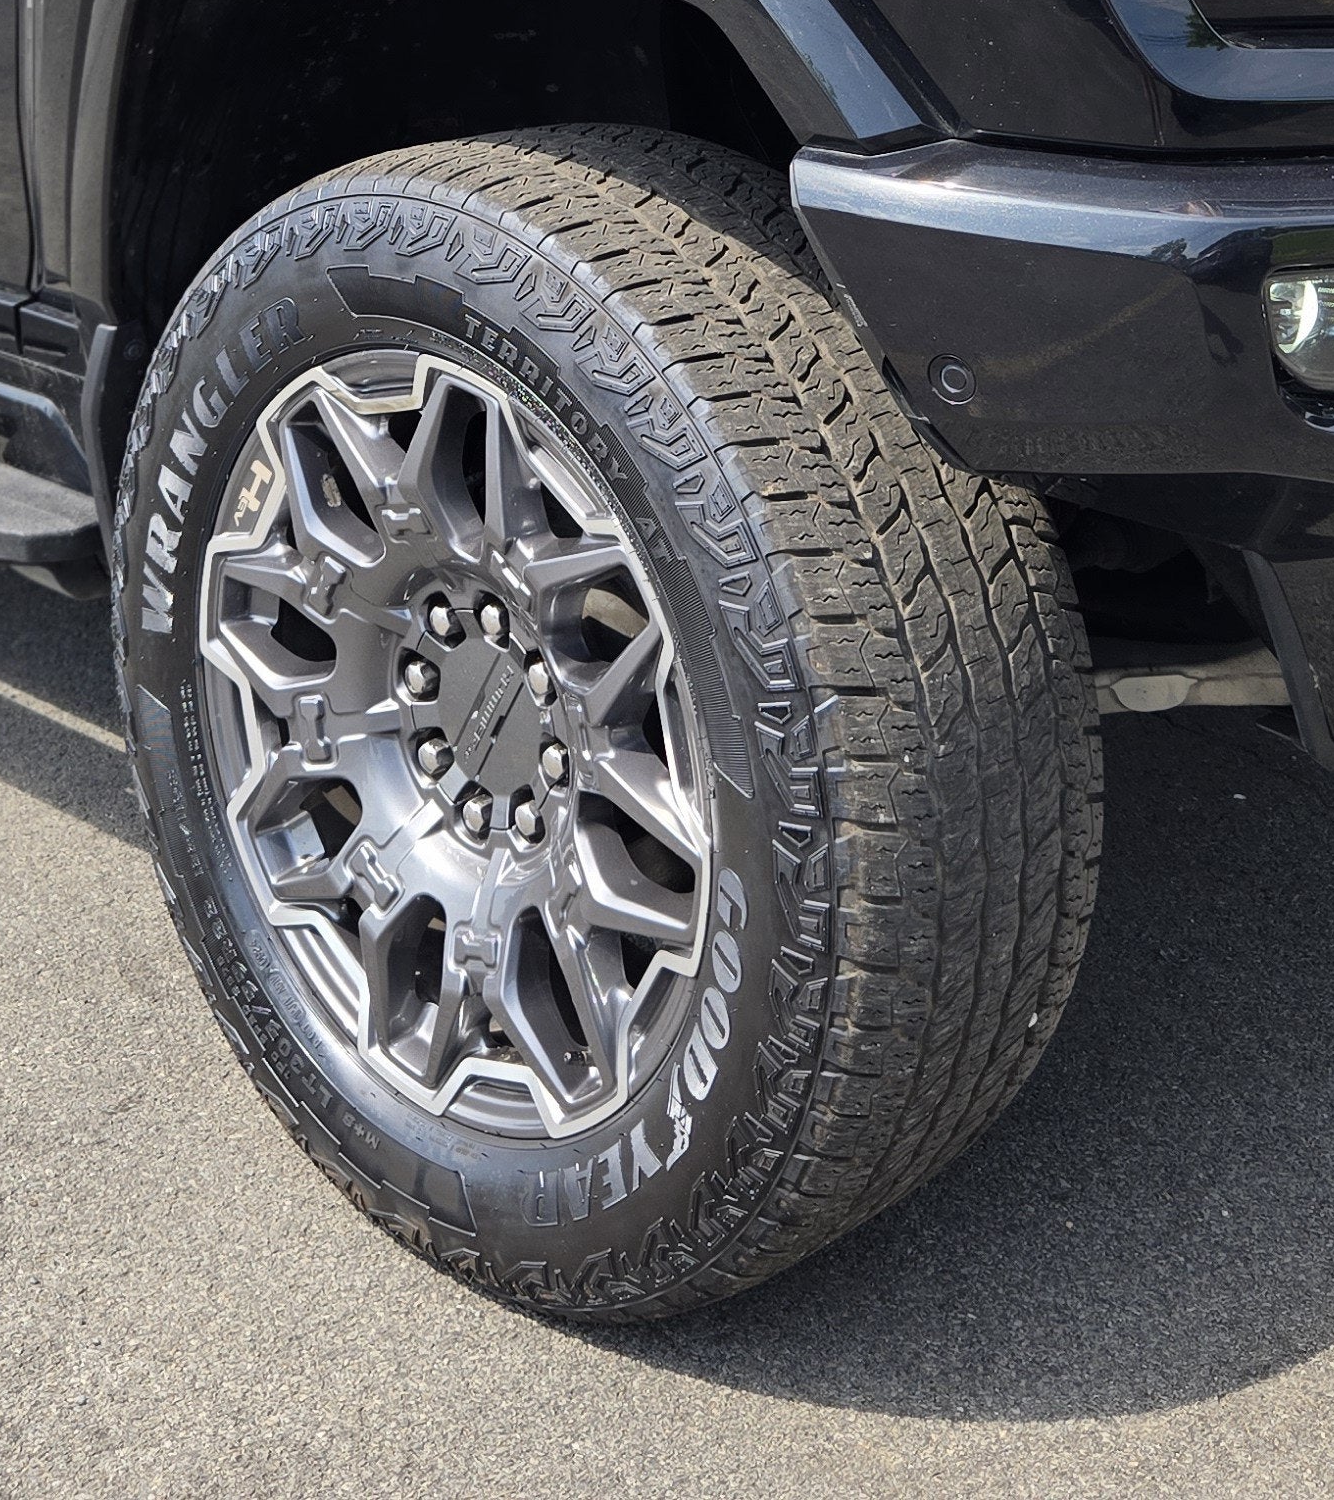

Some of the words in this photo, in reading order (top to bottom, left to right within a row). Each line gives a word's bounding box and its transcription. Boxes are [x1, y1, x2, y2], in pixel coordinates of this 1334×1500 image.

[141, 298, 310, 634] WRANGLER
[464, 313, 628, 482] TERRITORY
[521, 866, 748, 1228] GOODYEAR
